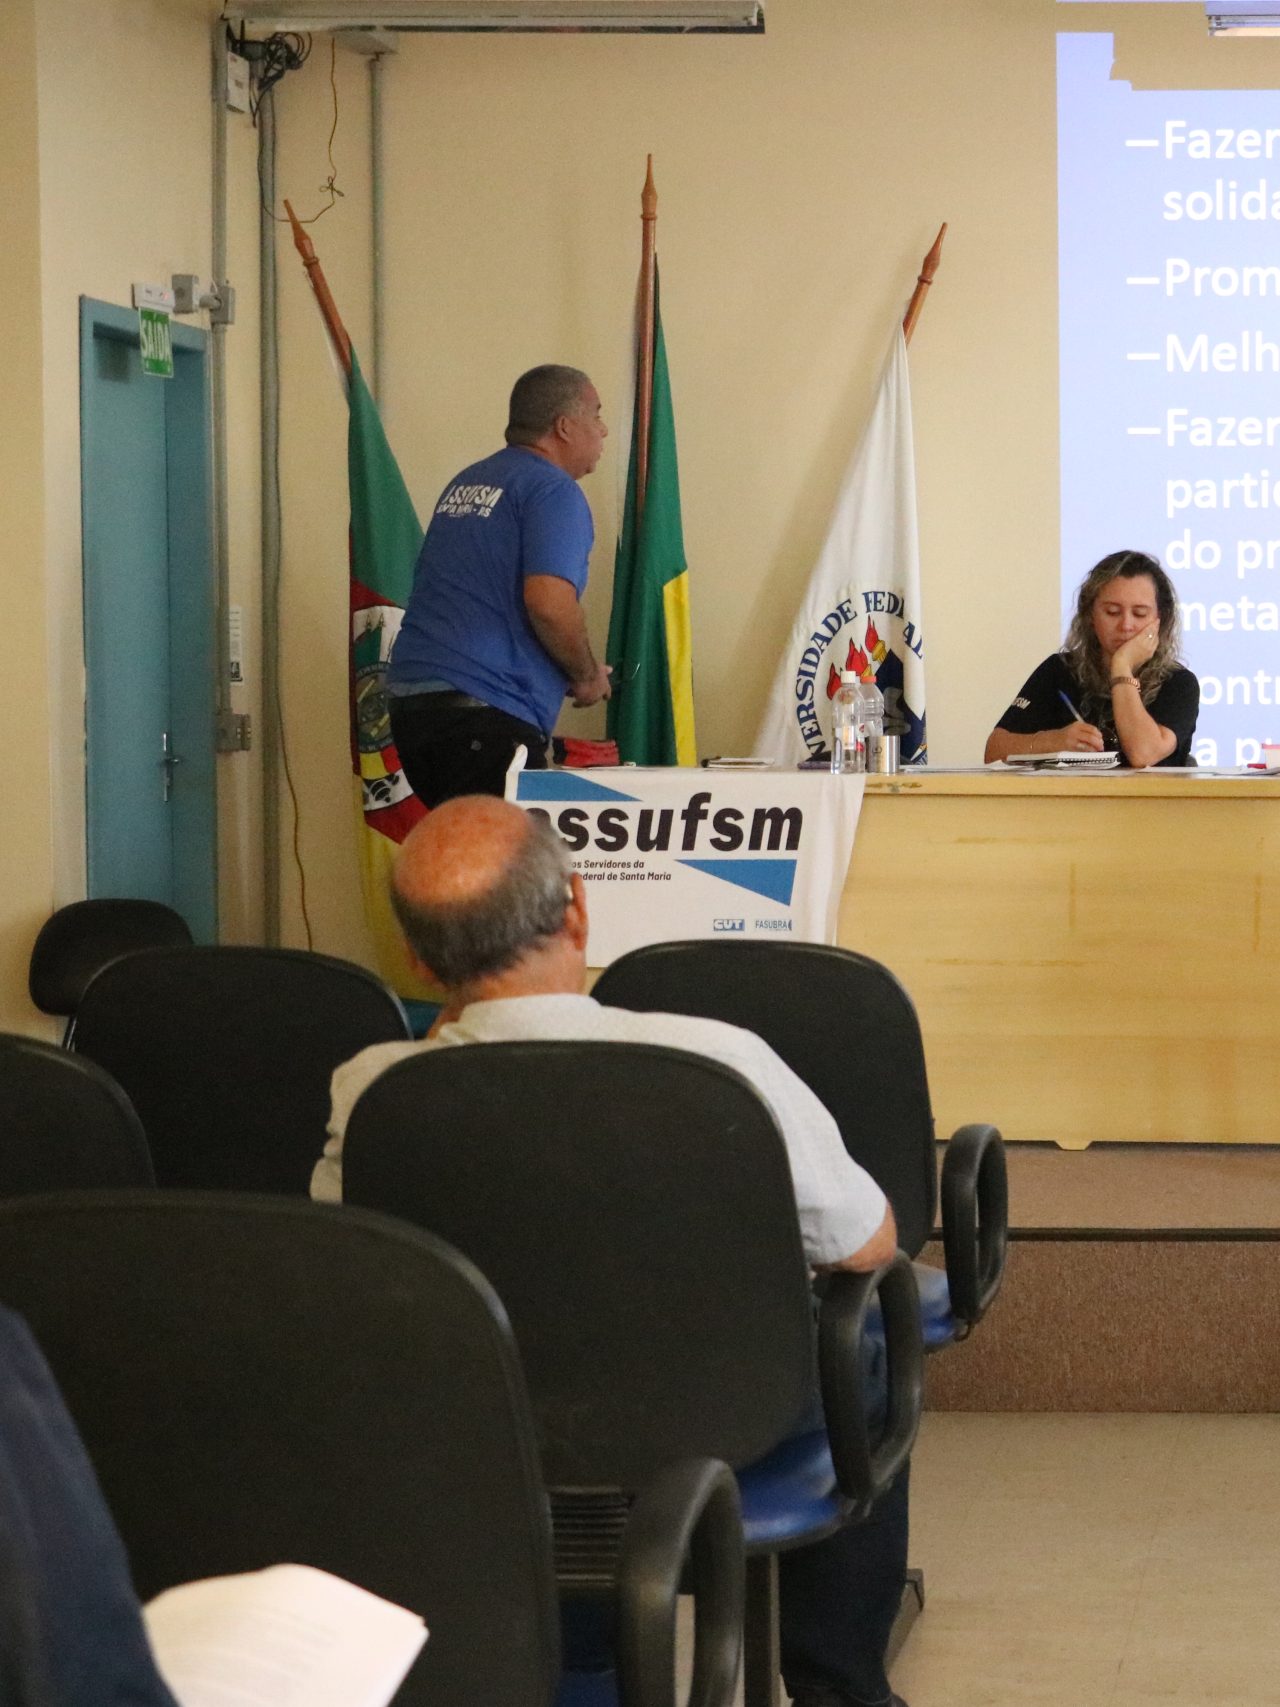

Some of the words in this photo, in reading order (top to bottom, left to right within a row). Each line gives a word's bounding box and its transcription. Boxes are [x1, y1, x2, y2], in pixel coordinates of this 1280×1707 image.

[1165, 528, 1223, 571] do
[795, 599, 858, 756] VERSIDADE
[862, 590, 923, 660] FEDAL
[524, 791, 804, 852] ssufsm
[579, 871, 605, 881] deral
[607, 872, 618, 881] de
[620, 872, 646, 881] Santa
[648, 872, 672, 881] Maria
[584, 859, 631, 869] Servidores
[633, 859, 645, 869] da
[714, 919, 743, 930] CUT
